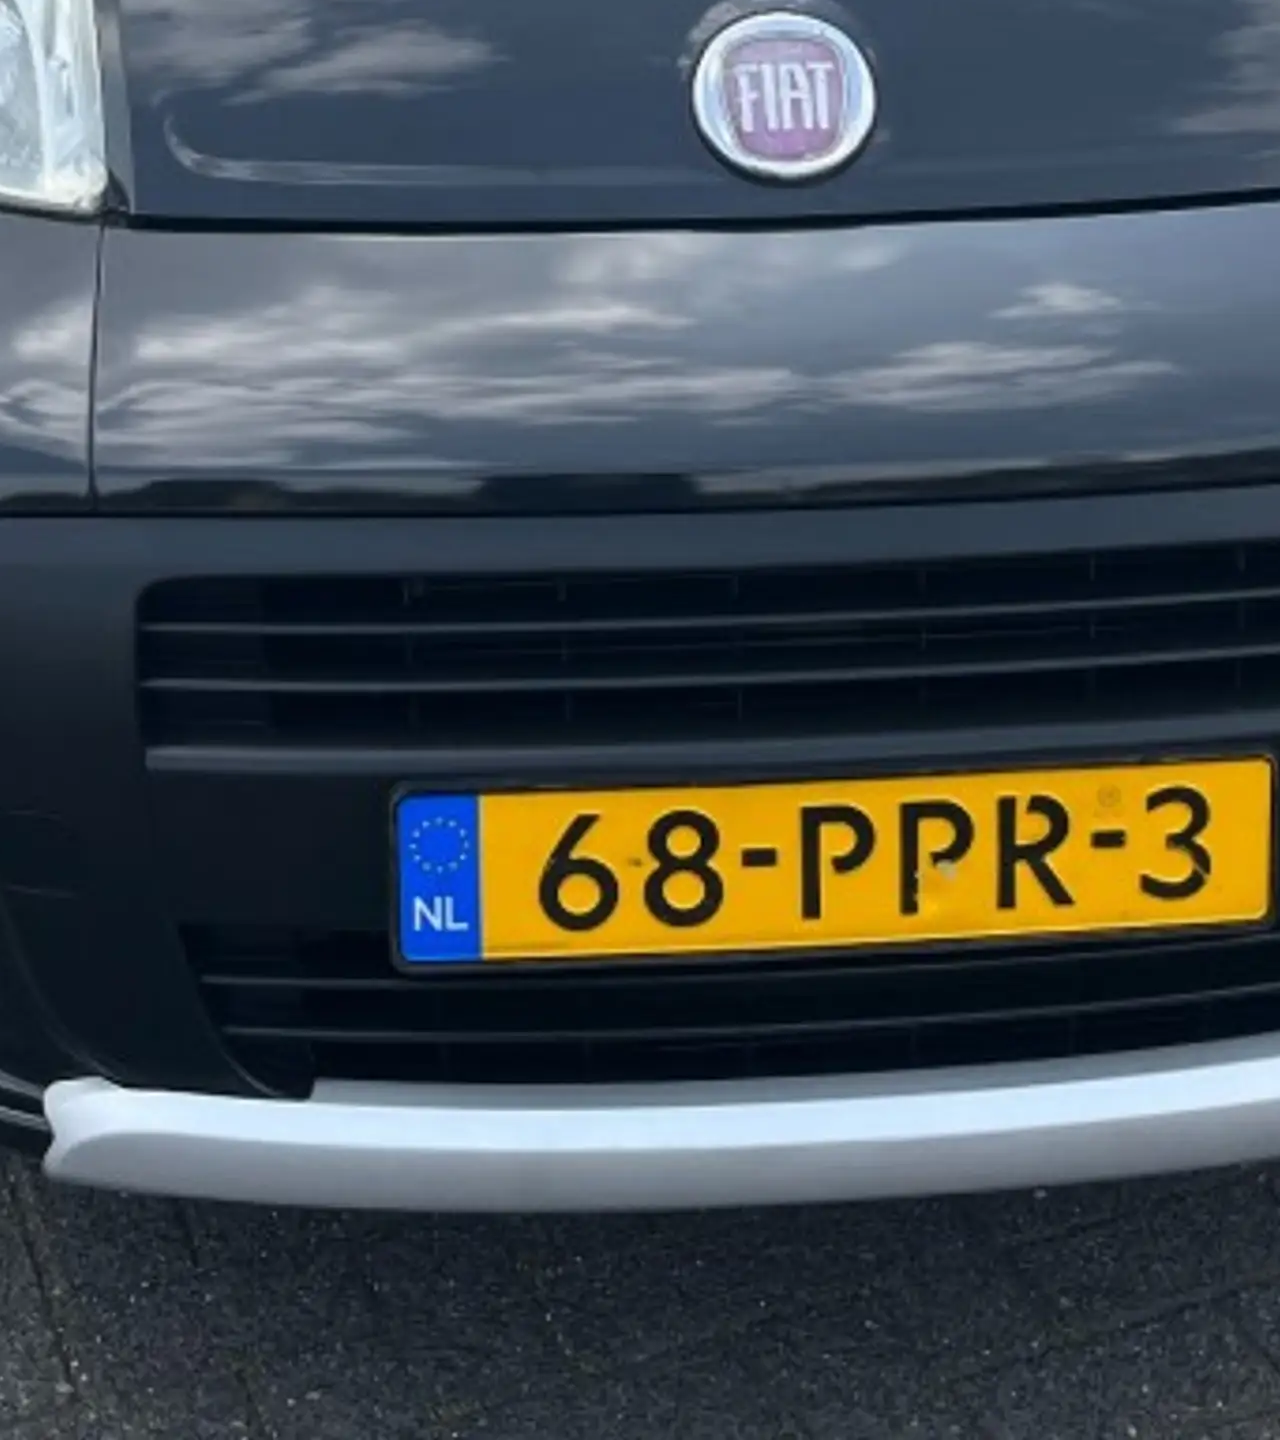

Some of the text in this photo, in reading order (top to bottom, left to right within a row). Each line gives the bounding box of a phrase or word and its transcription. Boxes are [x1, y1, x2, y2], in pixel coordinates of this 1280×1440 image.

[732, 60, 835, 133] FIAT
[537, 785, 1212, 933] 68-PPR-3
[412, 895, 469, 933] NL
